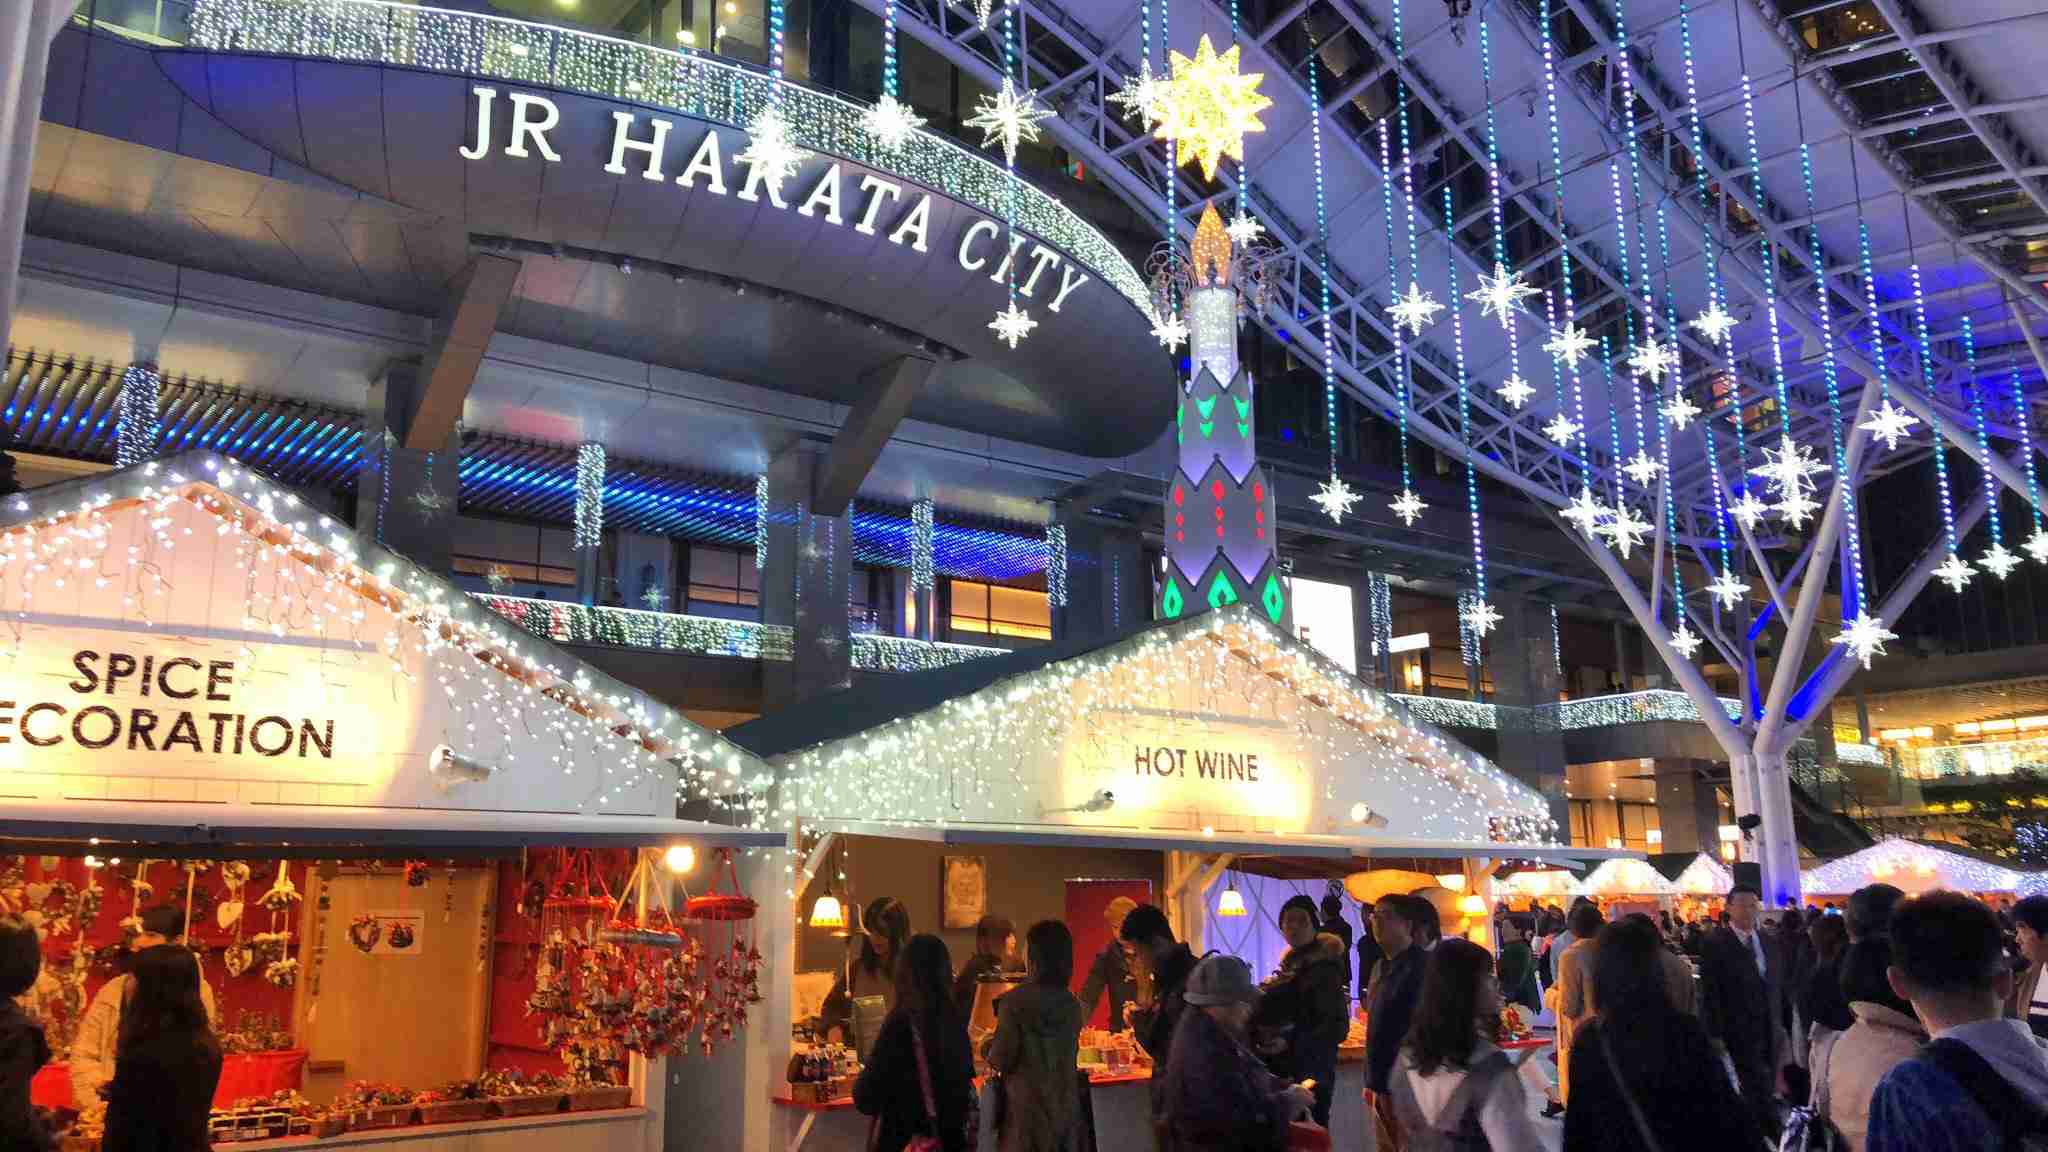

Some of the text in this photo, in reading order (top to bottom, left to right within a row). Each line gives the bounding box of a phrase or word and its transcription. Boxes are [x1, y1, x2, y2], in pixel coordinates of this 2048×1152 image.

[459, 87, 561, 161] JR
[958, 219, 1089, 313] CITY
[69, 649, 234, 701] SPICE
[1135, 745, 1259, 782] HOT WINE
